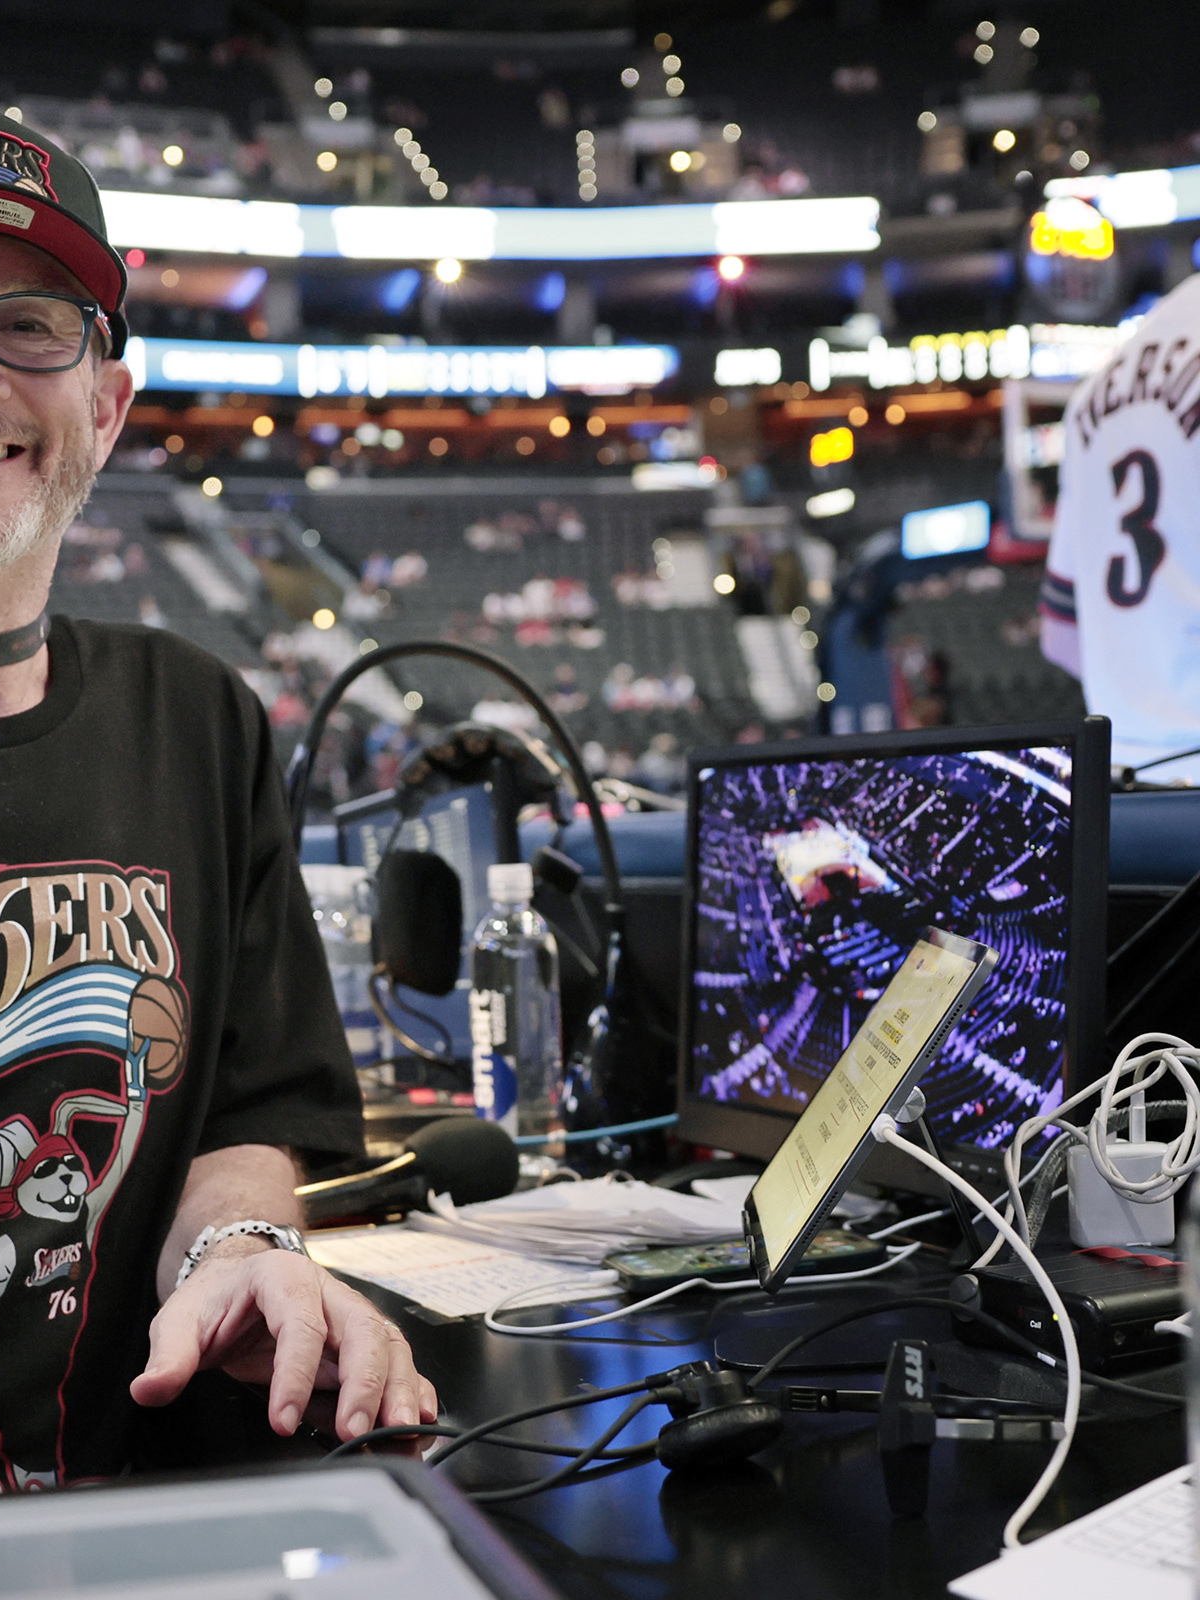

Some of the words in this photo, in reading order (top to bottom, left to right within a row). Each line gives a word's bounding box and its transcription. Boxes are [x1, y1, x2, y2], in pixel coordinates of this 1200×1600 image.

[1107, 450, 1165, 606] 3
[468, 986, 495, 1109] smart
[48, 1286, 77, 1319] 76
[1029, 1319, 1042, 1330] Call
[904, 1345, 924, 1399] RTS
